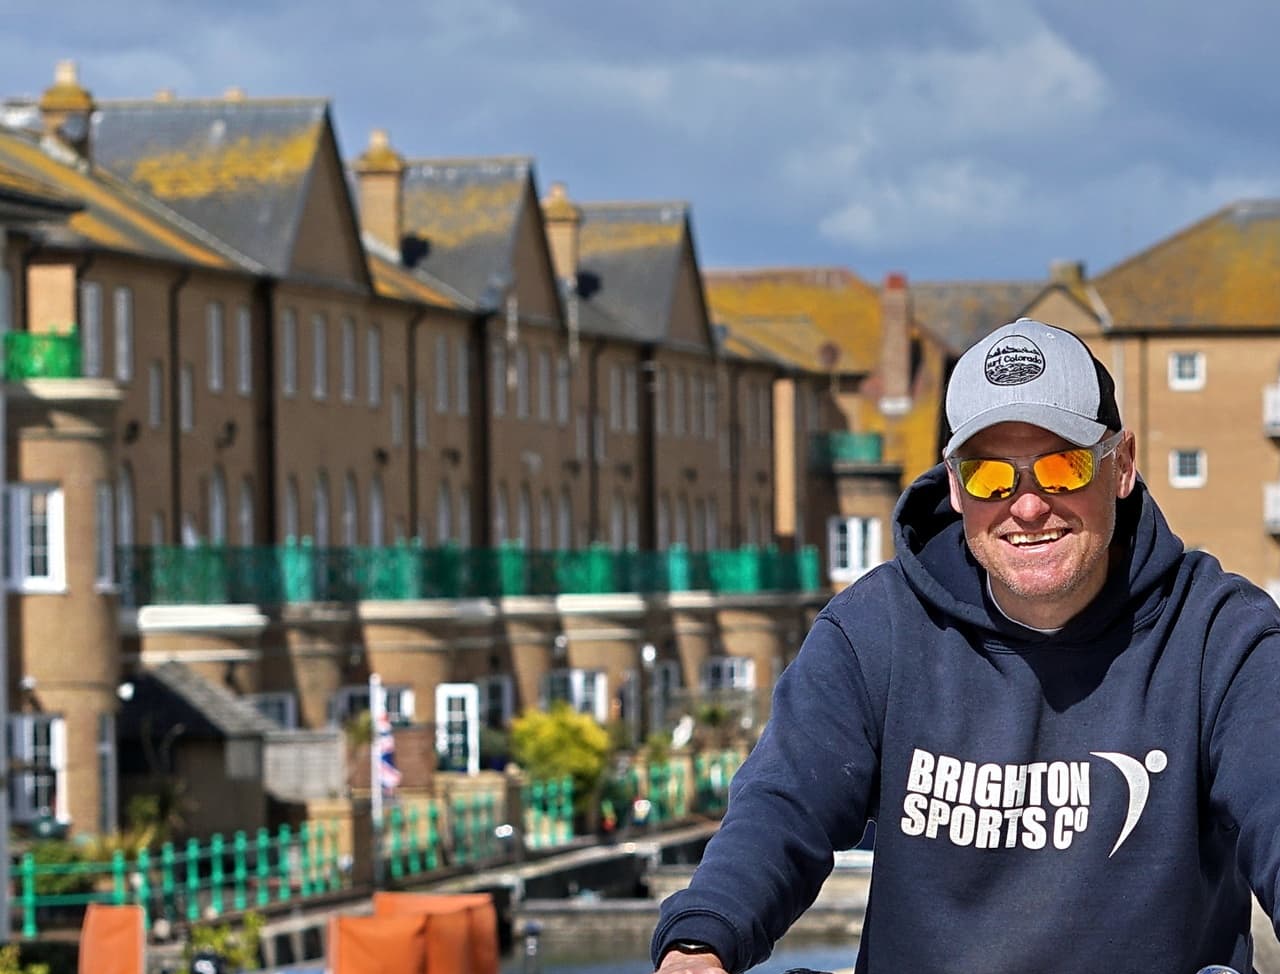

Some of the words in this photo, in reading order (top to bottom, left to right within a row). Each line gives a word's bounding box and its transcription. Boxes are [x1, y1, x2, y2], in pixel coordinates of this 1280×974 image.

[1003, 354, 1042, 365] Colorado
[907, 749, 1090, 807] BRIGHTON
[900, 793, 1047, 850] SPORTS
